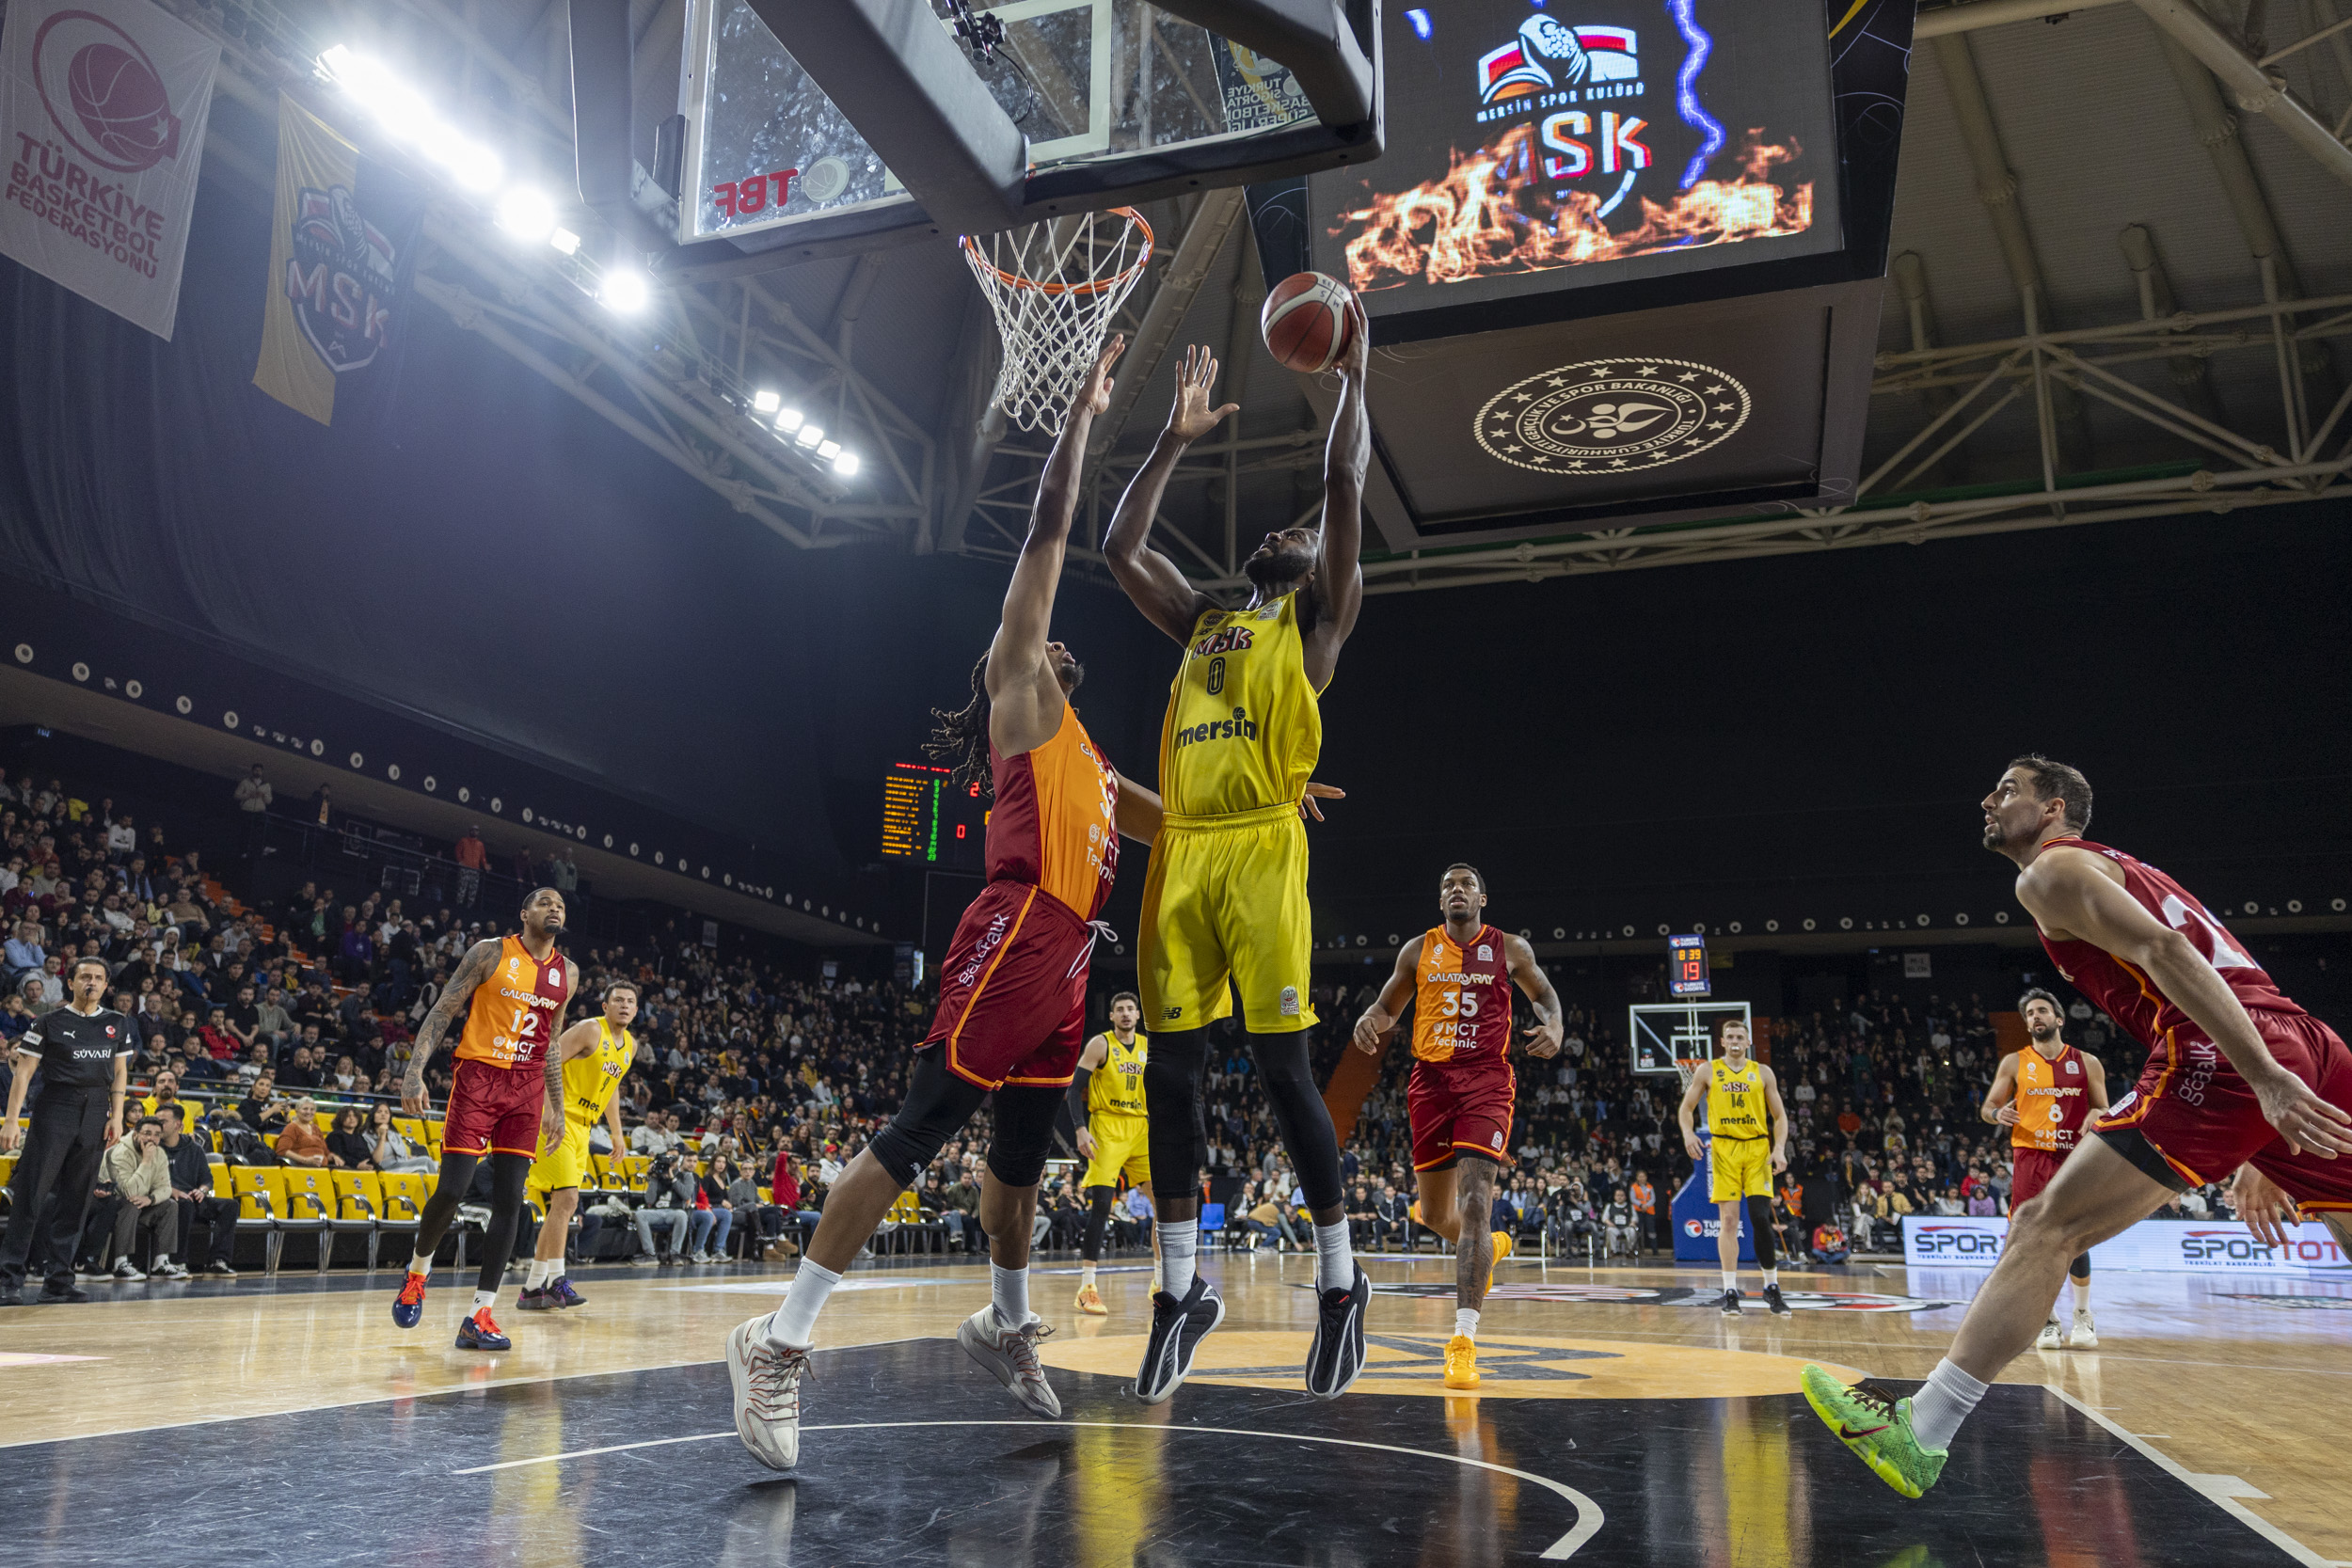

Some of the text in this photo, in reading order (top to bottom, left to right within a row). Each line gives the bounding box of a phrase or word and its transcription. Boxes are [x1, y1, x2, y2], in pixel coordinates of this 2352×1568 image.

[1476, 82, 1645, 123] MERSİN SPOR KULÜBÜ
[16, 131, 165, 242] TÜRKİYE
[10, 161, 159, 262] BASKETBOL
[6, 183, 157, 279] FEDERASYONU
[286, 261, 390, 349] MSK
[1523, 382, 1693, 441] GENÇLİK VE SPOR BAKANLIĞI
[1532, 420, 1696, 456] TÜRKİYE CUMHURİYETİ
[1191, 626, 1255, 660] MSK
[1206, 657, 1226, 696] 0
[1179, 706, 1257, 750] mersin
[956, 824, 966, 839] 0
[1427, 973, 1496, 986] GALATASARAY
[1683, 961, 1699, 980] 19
[500, 987, 559, 1010] GALATASARAY
[1441, 991, 1479, 1017] 35
[511, 1009, 538, 1037] 12
[1445, 1022, 1480, 1037] MCT
[506, 1038, 536, 1054] MCT
[1433, 1036, 1477, 1049] Technic
[601, 1061, 622, 1079] MSK
[1119, 1062, 1142, 1075] MSK
[1125, 1074, 1136, 1091] 10
[1722, 1082, 1750, 1092] MSK
[2026, 1087, 2083, 1098] GALATASARAY
[1110, 1098, 1142, 1110] mersin
[2048, 1103, 2063, 1123] 8
[1720, 1115, 1756, 1126] mersin
[2034, 1139, 2074, 1149] Technic
[2045, 1130, 2074, 1140] MCT
[1915, 1234, 2007, 1254] SPOR
